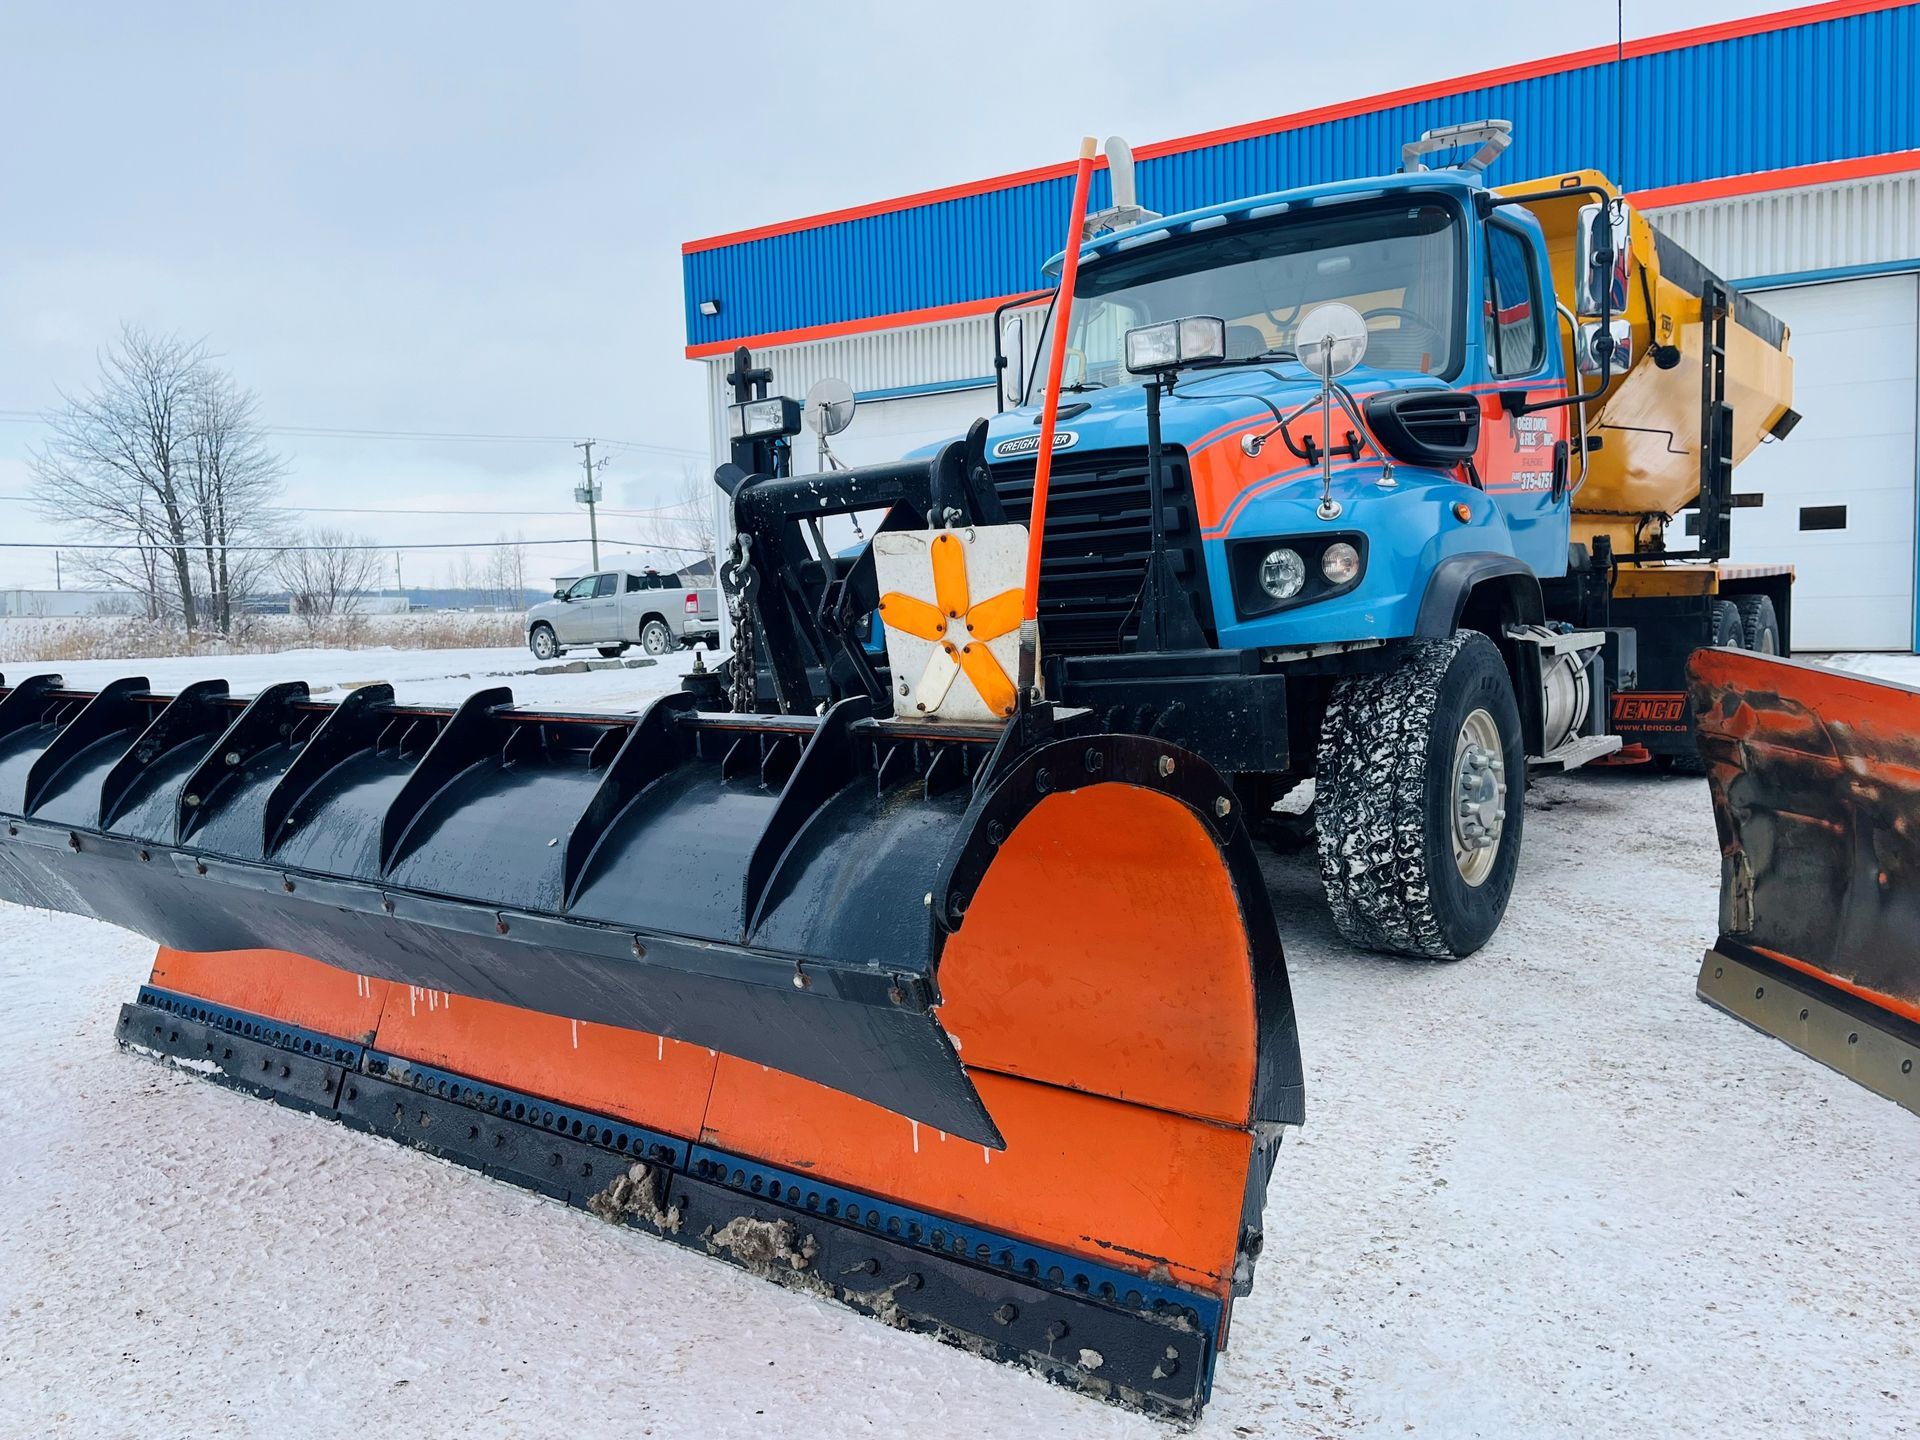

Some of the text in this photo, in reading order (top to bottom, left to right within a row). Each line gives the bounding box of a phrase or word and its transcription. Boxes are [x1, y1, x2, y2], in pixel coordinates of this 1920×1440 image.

[1000, 434, 1069, 452] FREIGHTER
[1611, 693, 1686, 720] TENCO
[1615, 723, 1687, 732] www.tenco.ca
